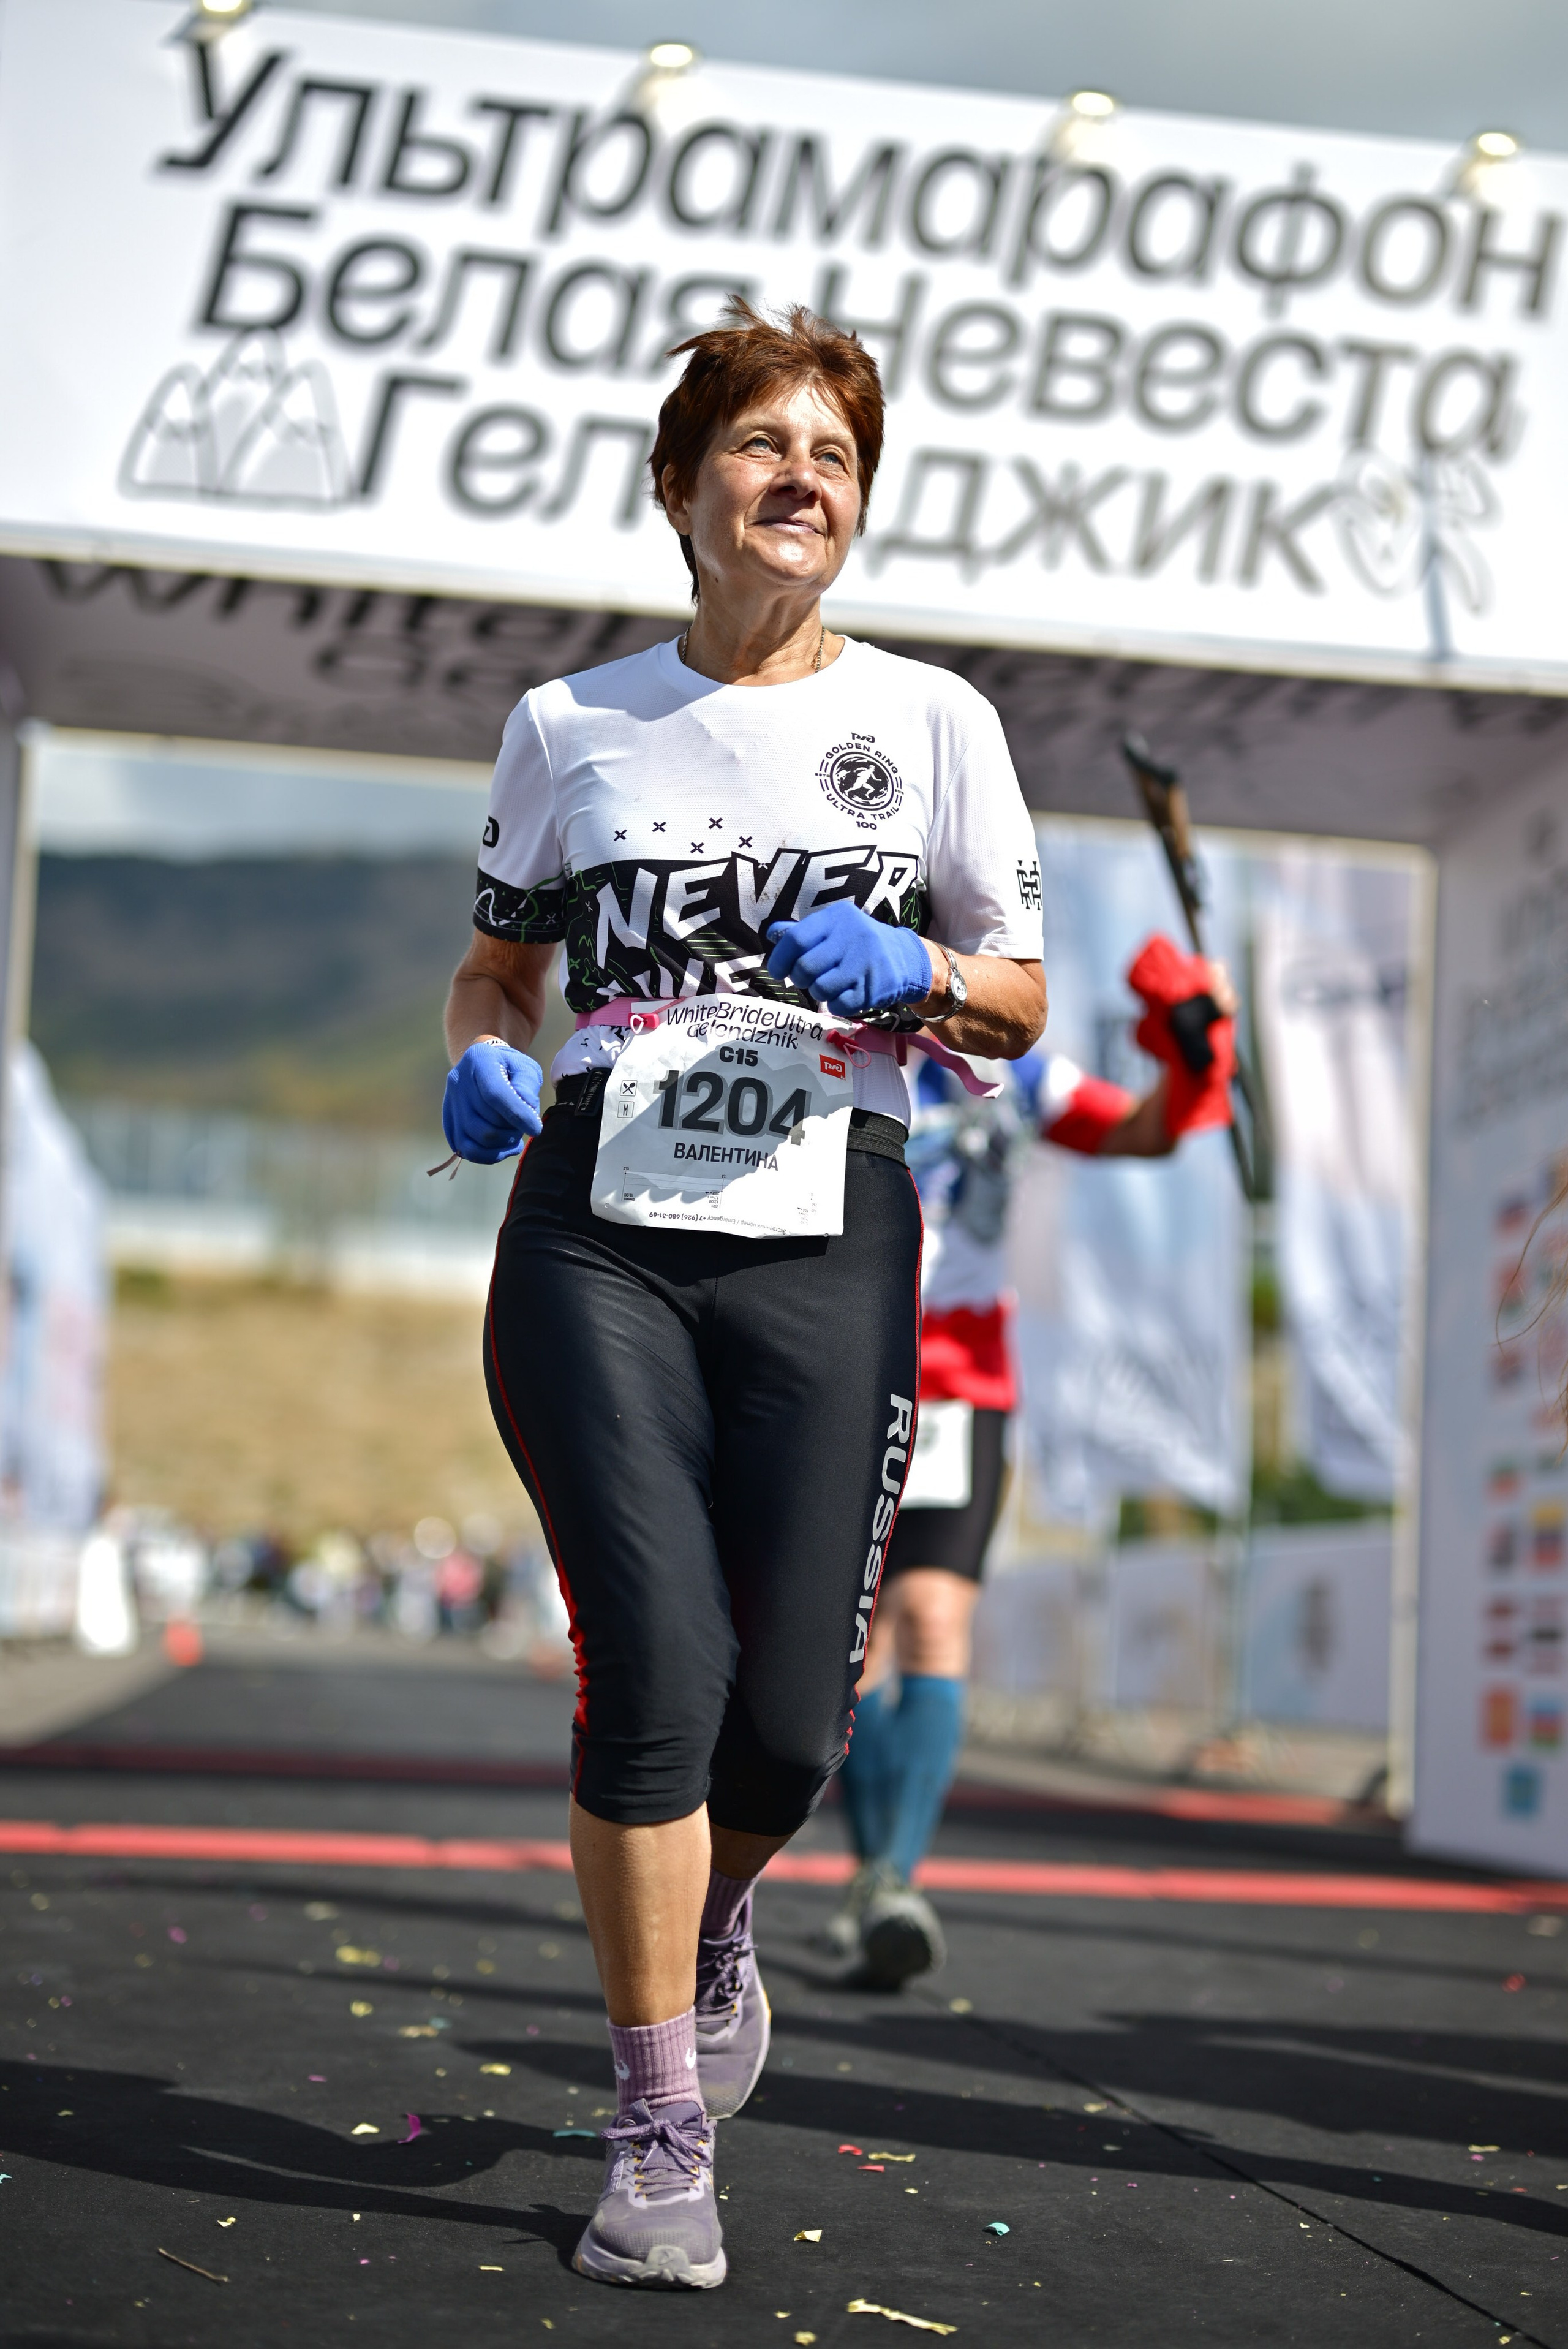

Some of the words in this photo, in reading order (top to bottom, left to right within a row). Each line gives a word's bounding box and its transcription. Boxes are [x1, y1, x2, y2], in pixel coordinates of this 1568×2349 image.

[152, 39, 1564, 319] Ультрамарафон
[815, 265, 1521, 461] Невеста
[358, 373, 1341, 594] Гелджик
[826, 742, 870, 759] GOLDEN
[875, 751, 898, 774] RING
[827, 793, 865, 819] ULTRA
[871, 807, 899, 820] TRAIL
[856, 821, 877, 830] 100
[595, 846, 919, 969] NEVER
[720, 1046, 758, 1067] C15
[654, 1070, 812, 1146] 1204
[674, 1143, 778, 1171] ВАЛЕНТИНА
[707, 1215, 736, 1224] Emergency
[850, 1393, 913, 1663] RUSSIA
